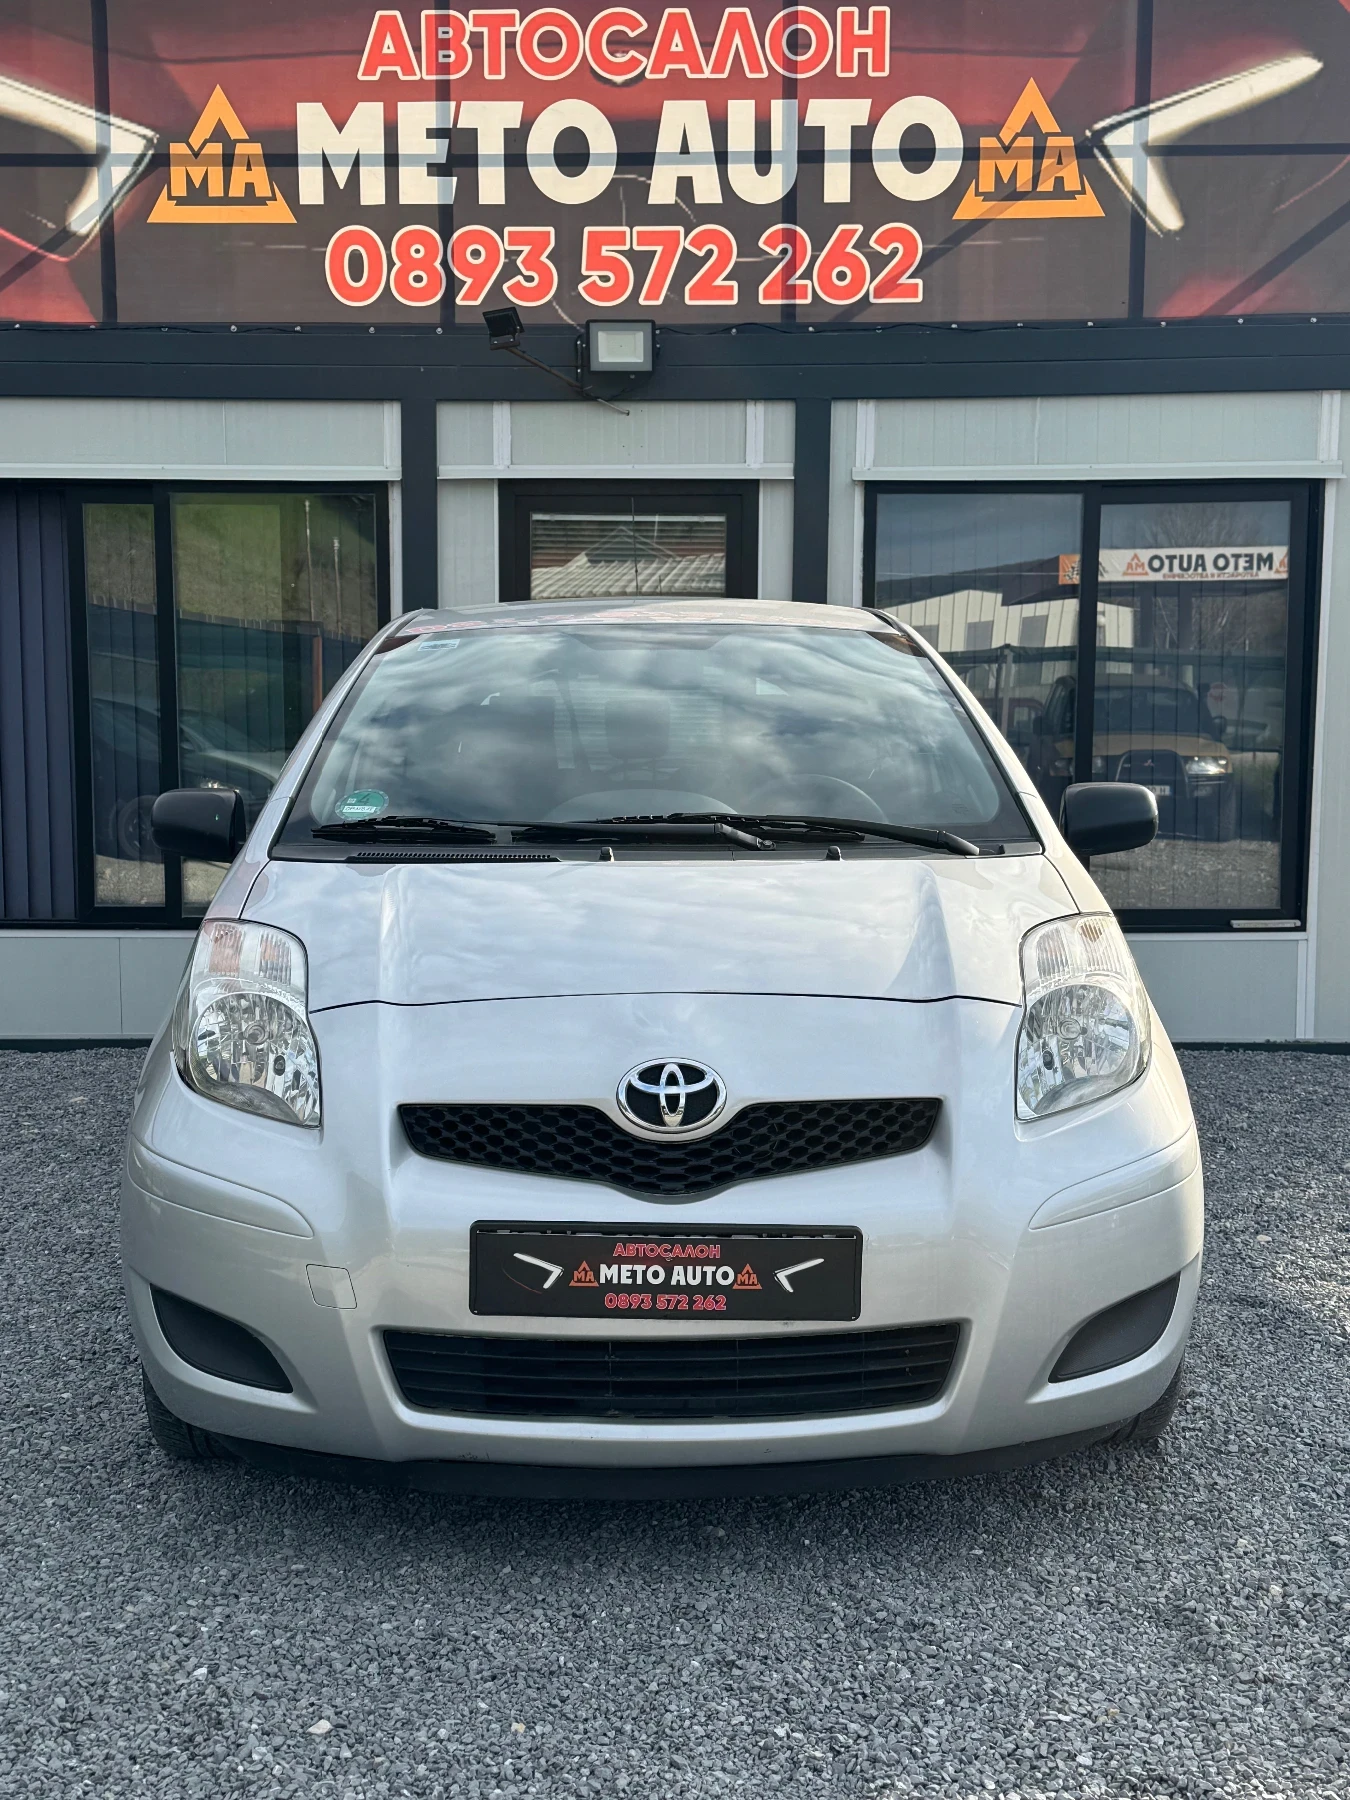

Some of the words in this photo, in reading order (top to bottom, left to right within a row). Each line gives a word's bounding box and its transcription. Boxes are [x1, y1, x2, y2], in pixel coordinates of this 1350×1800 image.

[358, 7, 891, 80] АВТОСАЛОН
[169, 142, 273, 198] MA
[296, 98, 618, 206] METO
[648, 95, 964, 205] AUTO
[978, 136, 1083, 193] MA
[325, 224, 558, 306] 0893
[579, 224, 738, 306] 572
[758, 222, 923, 305] 262
[573, 1270, 595, 1283] MA
[599, 1263, 664, 1285] METO
[670, 1265, 735, 1286] AUTO
[736, 1273, 758, 1285] MA
[612, 1243, 721, 1258] АВТОСАЛОН
[604, 1292, 652, 1310] 0893
[656, 1293, 689, 1311] 572
[692, 1294, 726, 1311] 262
